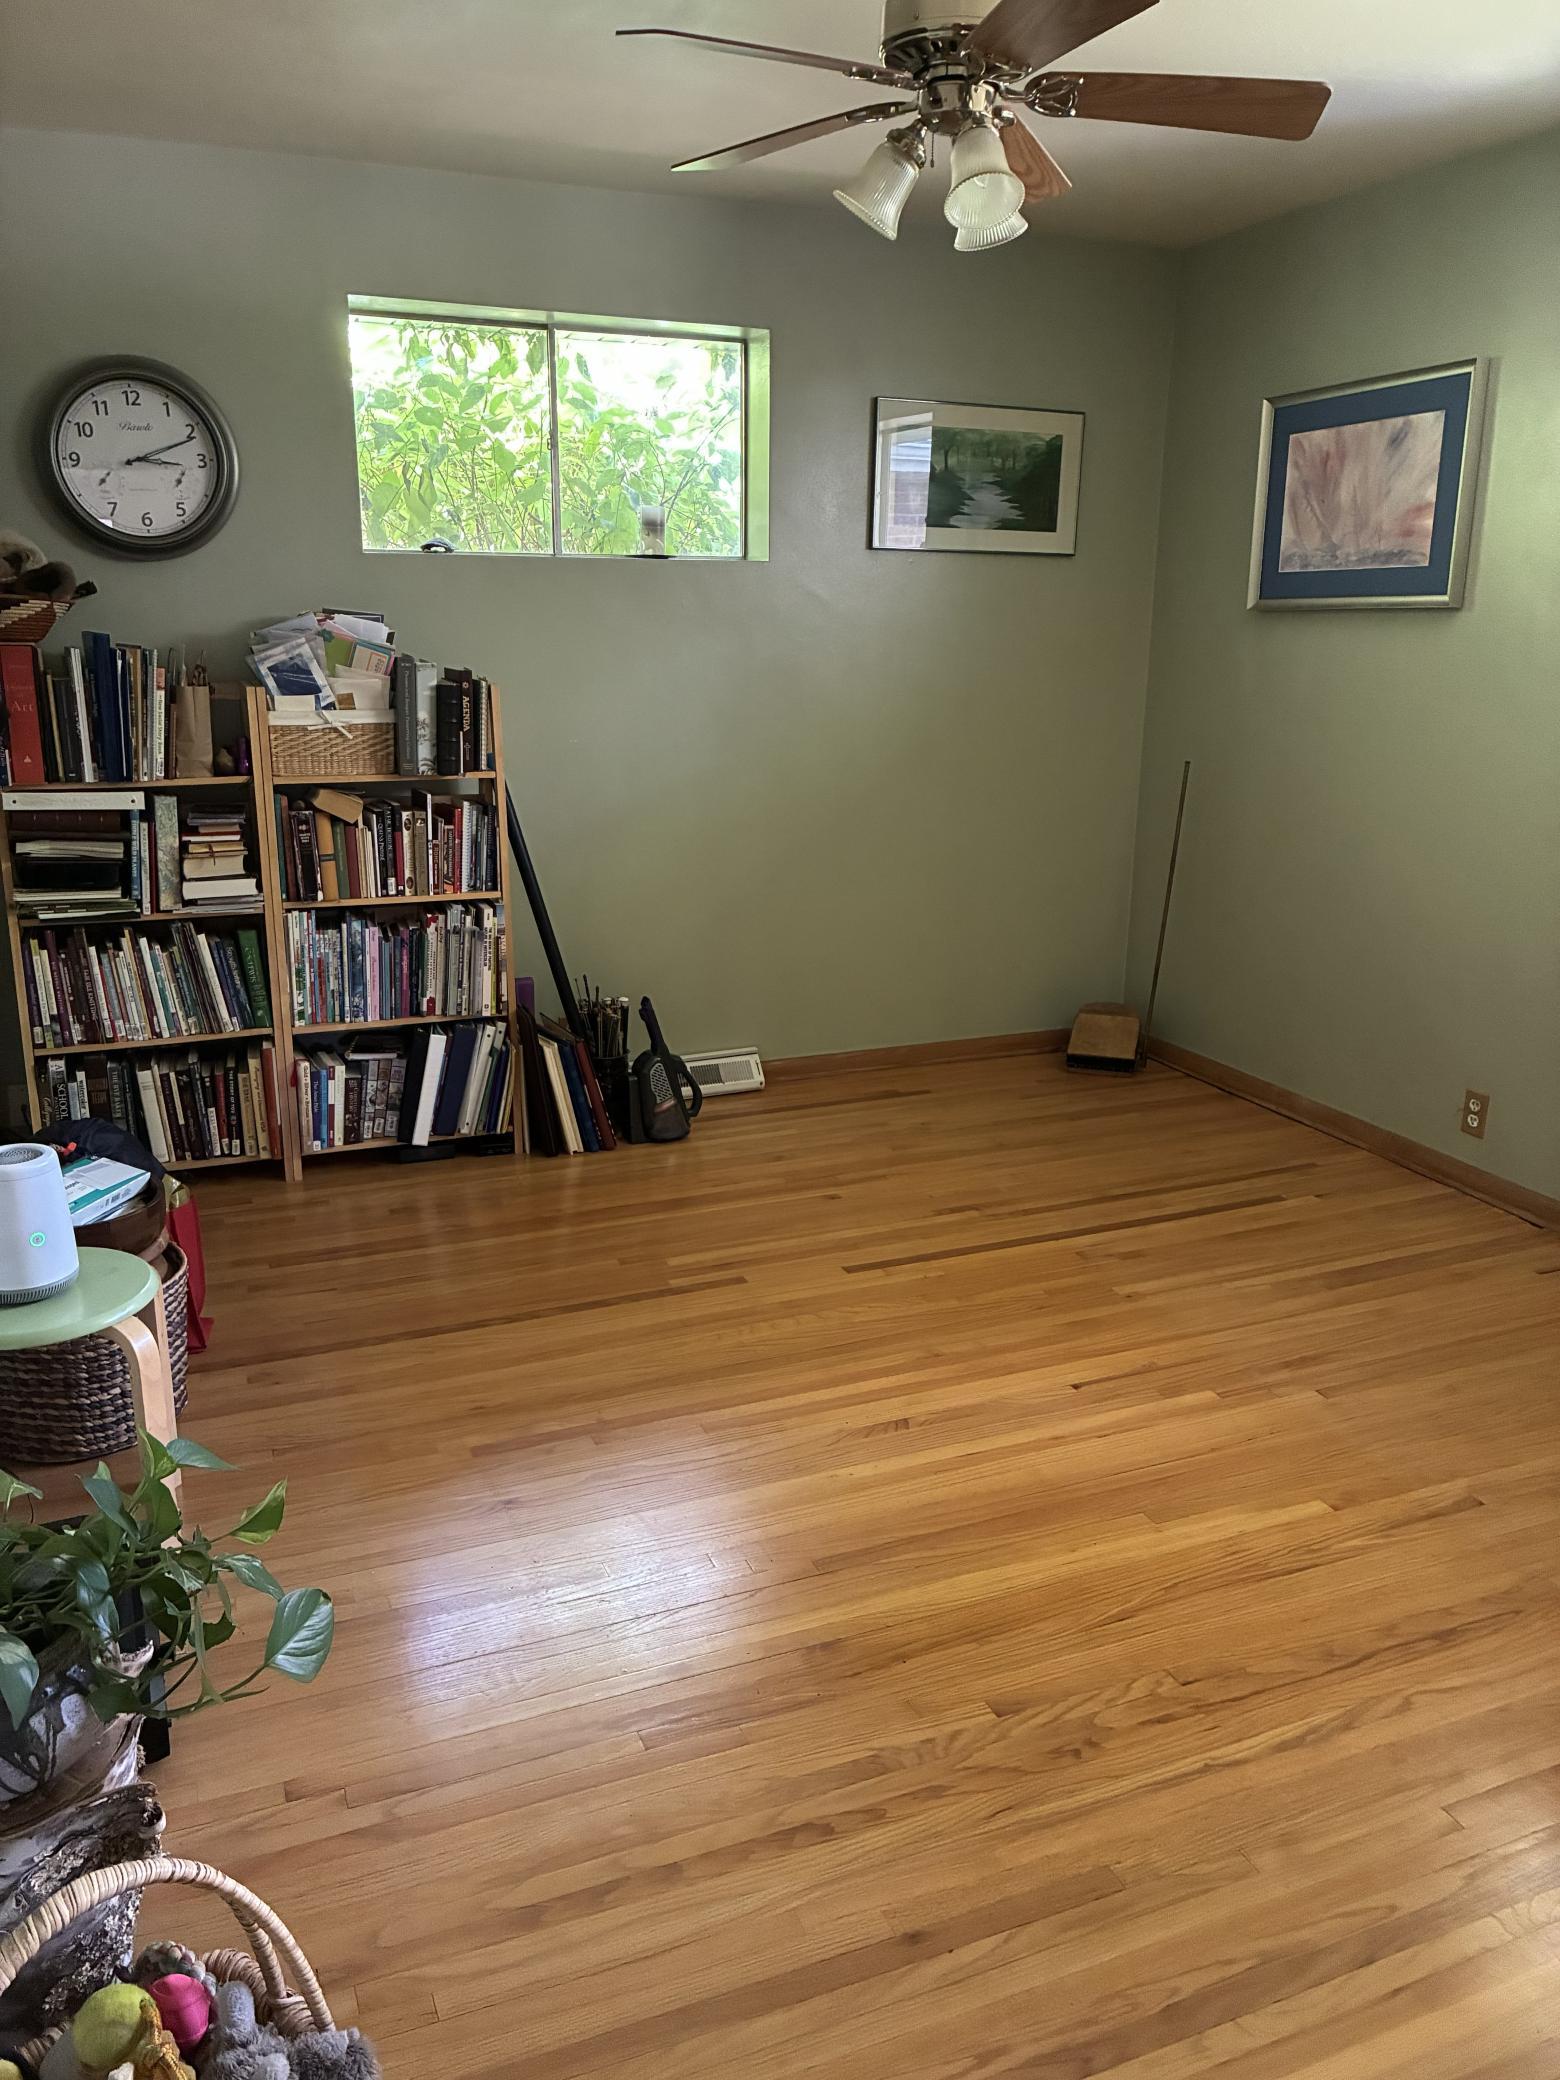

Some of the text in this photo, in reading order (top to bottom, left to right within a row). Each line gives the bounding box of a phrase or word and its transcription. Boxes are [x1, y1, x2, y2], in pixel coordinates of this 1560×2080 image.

[122, 390, 141, 407] 12
[92, 400, 108, 416] 11
[162, 402, 171, 418] 1
[74, 422, 94, 438] 10
[185, 424, 196, 439] 2
[68, 452, 80, 468] 9
[196, 454, 208, 468] 3
[107, 502, 118, 517] 7
[176, 502, 186, 517] 5
[142, 512, 154, 528] 6
[462, 696, 471, 732] AGENDA
[57, 1084, 69, 1120] SCHOOL
